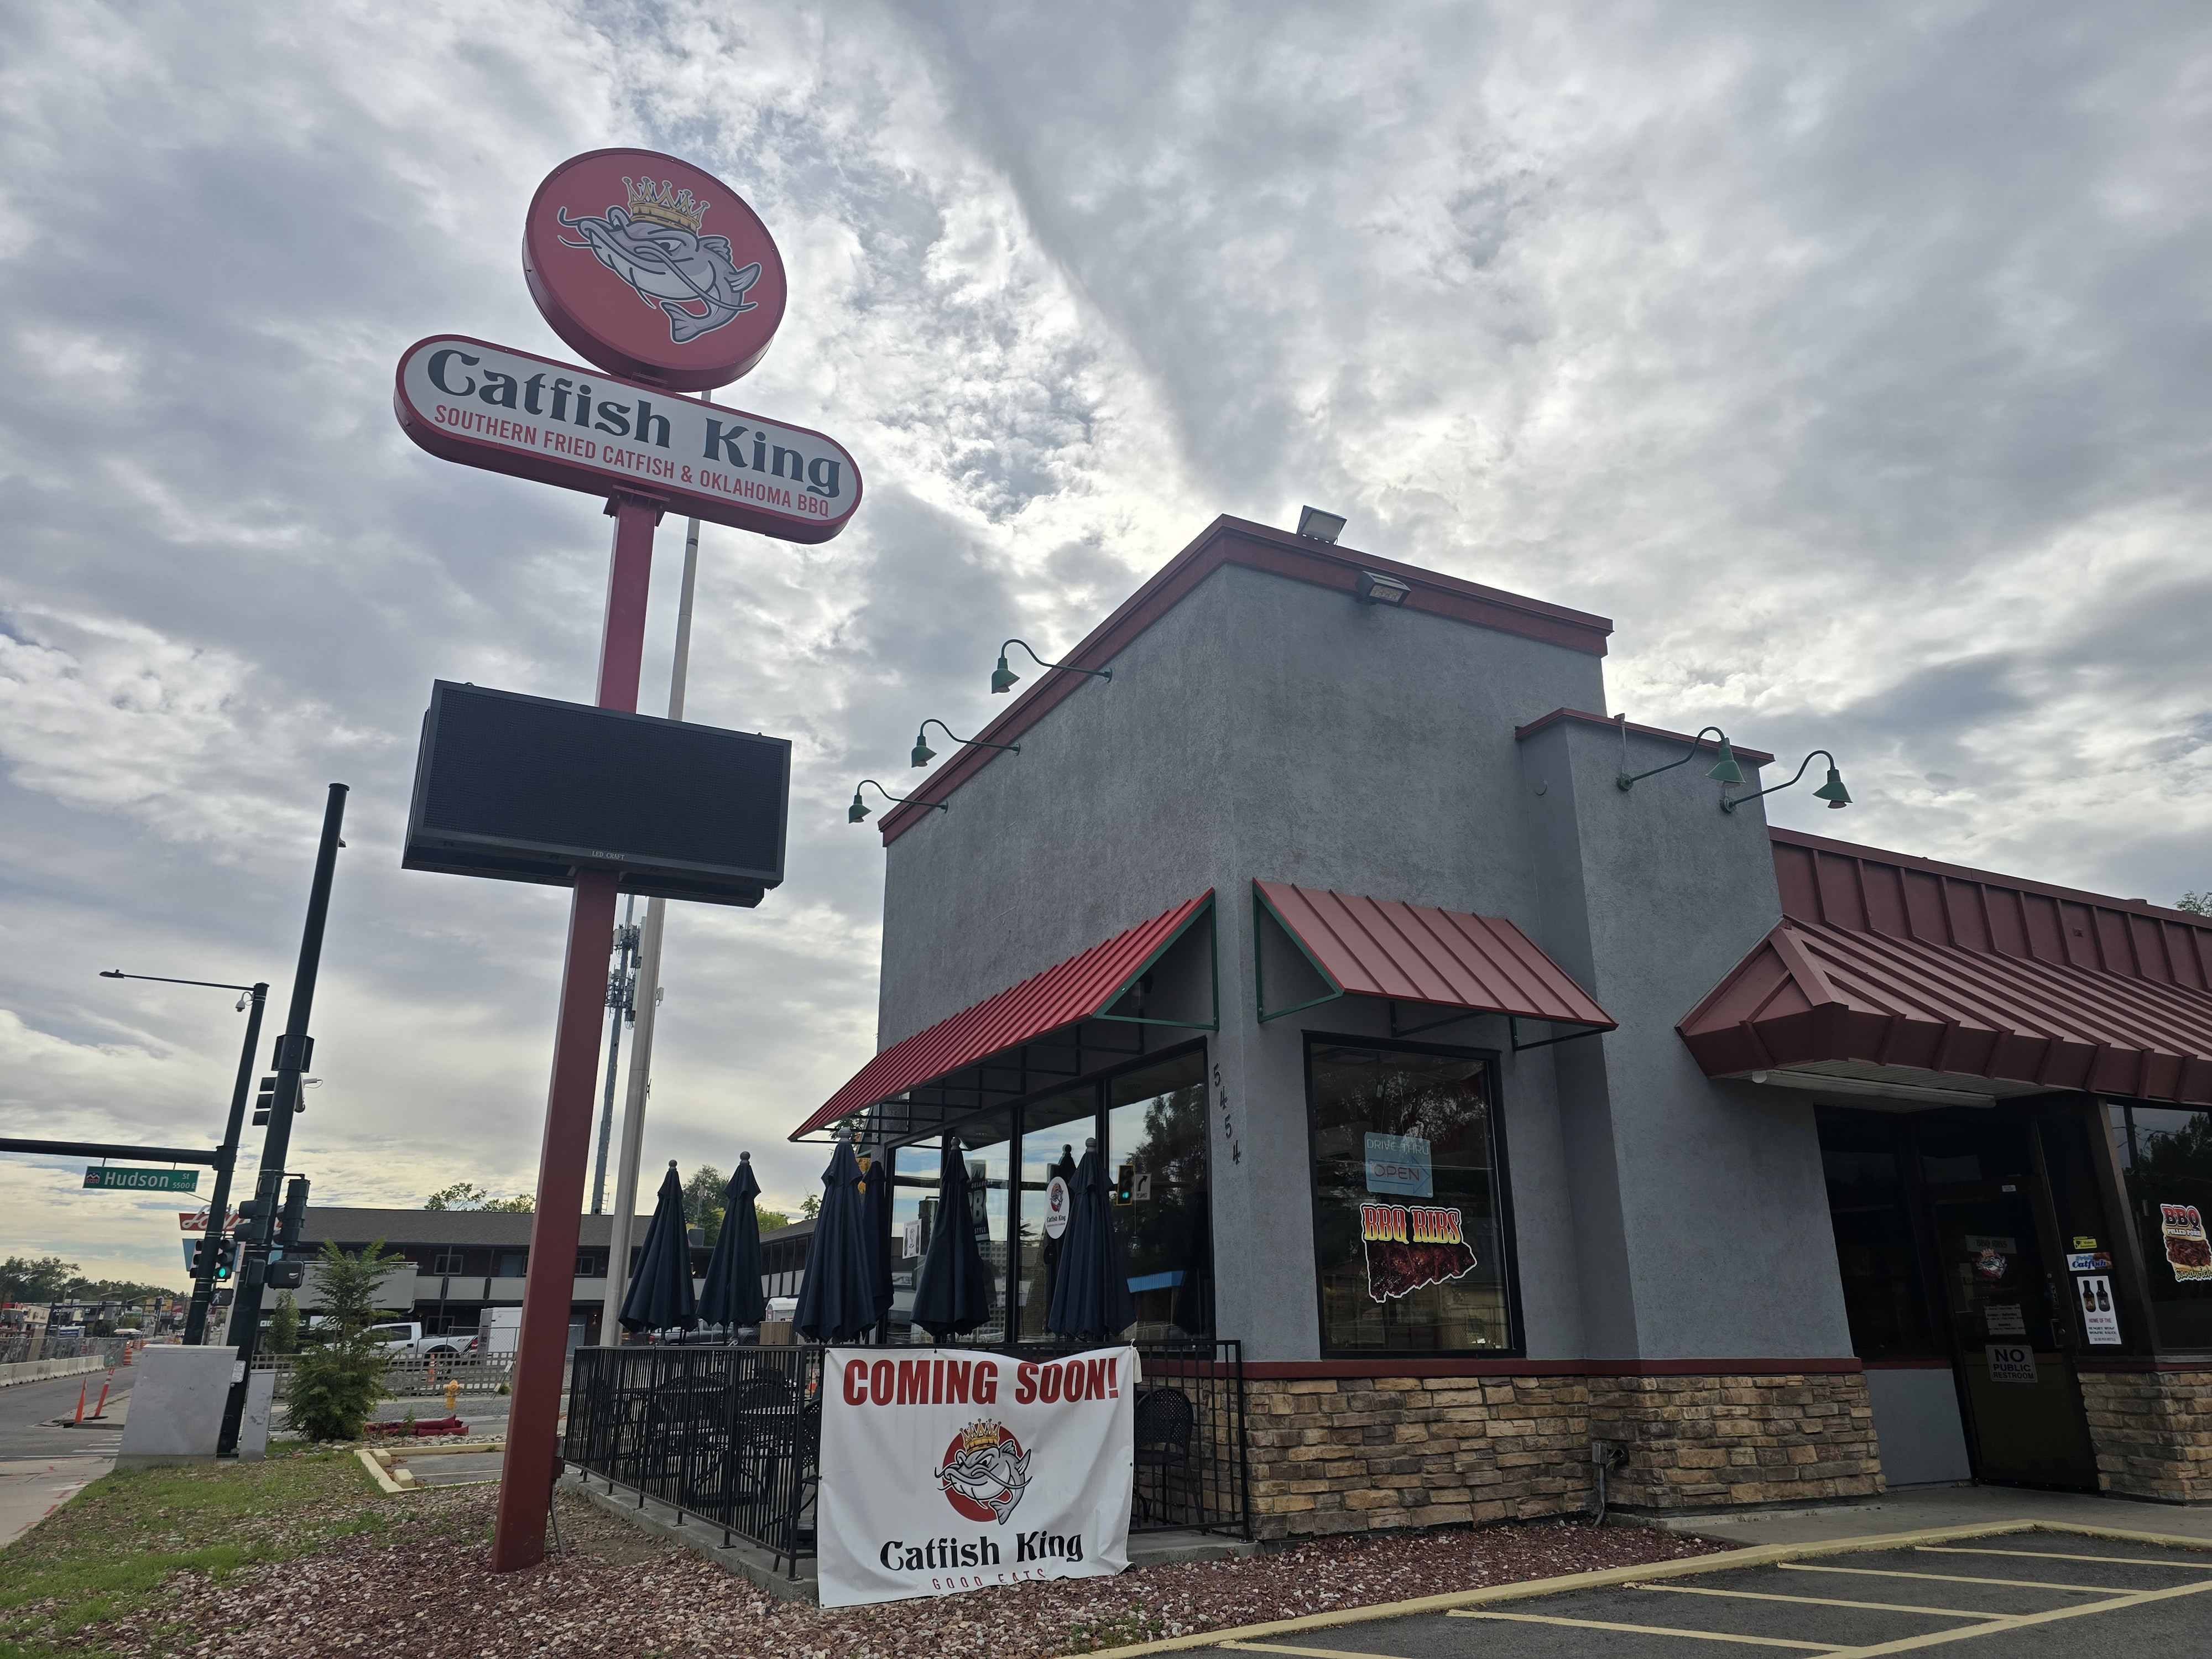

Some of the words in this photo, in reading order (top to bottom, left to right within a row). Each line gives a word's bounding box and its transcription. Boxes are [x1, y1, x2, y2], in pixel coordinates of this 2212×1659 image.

[428, 349, 670, 448] Catfish
[703, 418, 841, 498] King
[435, 405, 537, 443] SOUTHERN
[544, 431, 596, 459] FRIED
[603, 445, 674, 479] CATFISH
[681, 465, 693, 483] &
[700, 470, 791, 507] OKLAHOMA
[797, 495, 830, 518] BBQ
[1213, 1062, 1241, 1165] 5454
[104, 1171, 169, 1187] Hudson
[1374, 1164, 1419, 1181] OPEN
[1363, 1206, 1409, 1244] BBQ
[1412, 1208, 1461, 1244] RIBS
[2162, 1206, 2200, 1230] BBQ
[2072, 1260, 2106, 1269] Catfish
[1994, 1349, 2025, 1362] NO
[843, 1359, 998, 1406] COMING
[1015, 1357, 1119, 1405] SOON!
[880, 1535, 1000, 1571] Catfish
[1016, 1530, 1083, 1563] King
[932, 1576, 983, 1590] GOOD
[998, 1568, 1046, 1583] EATS
